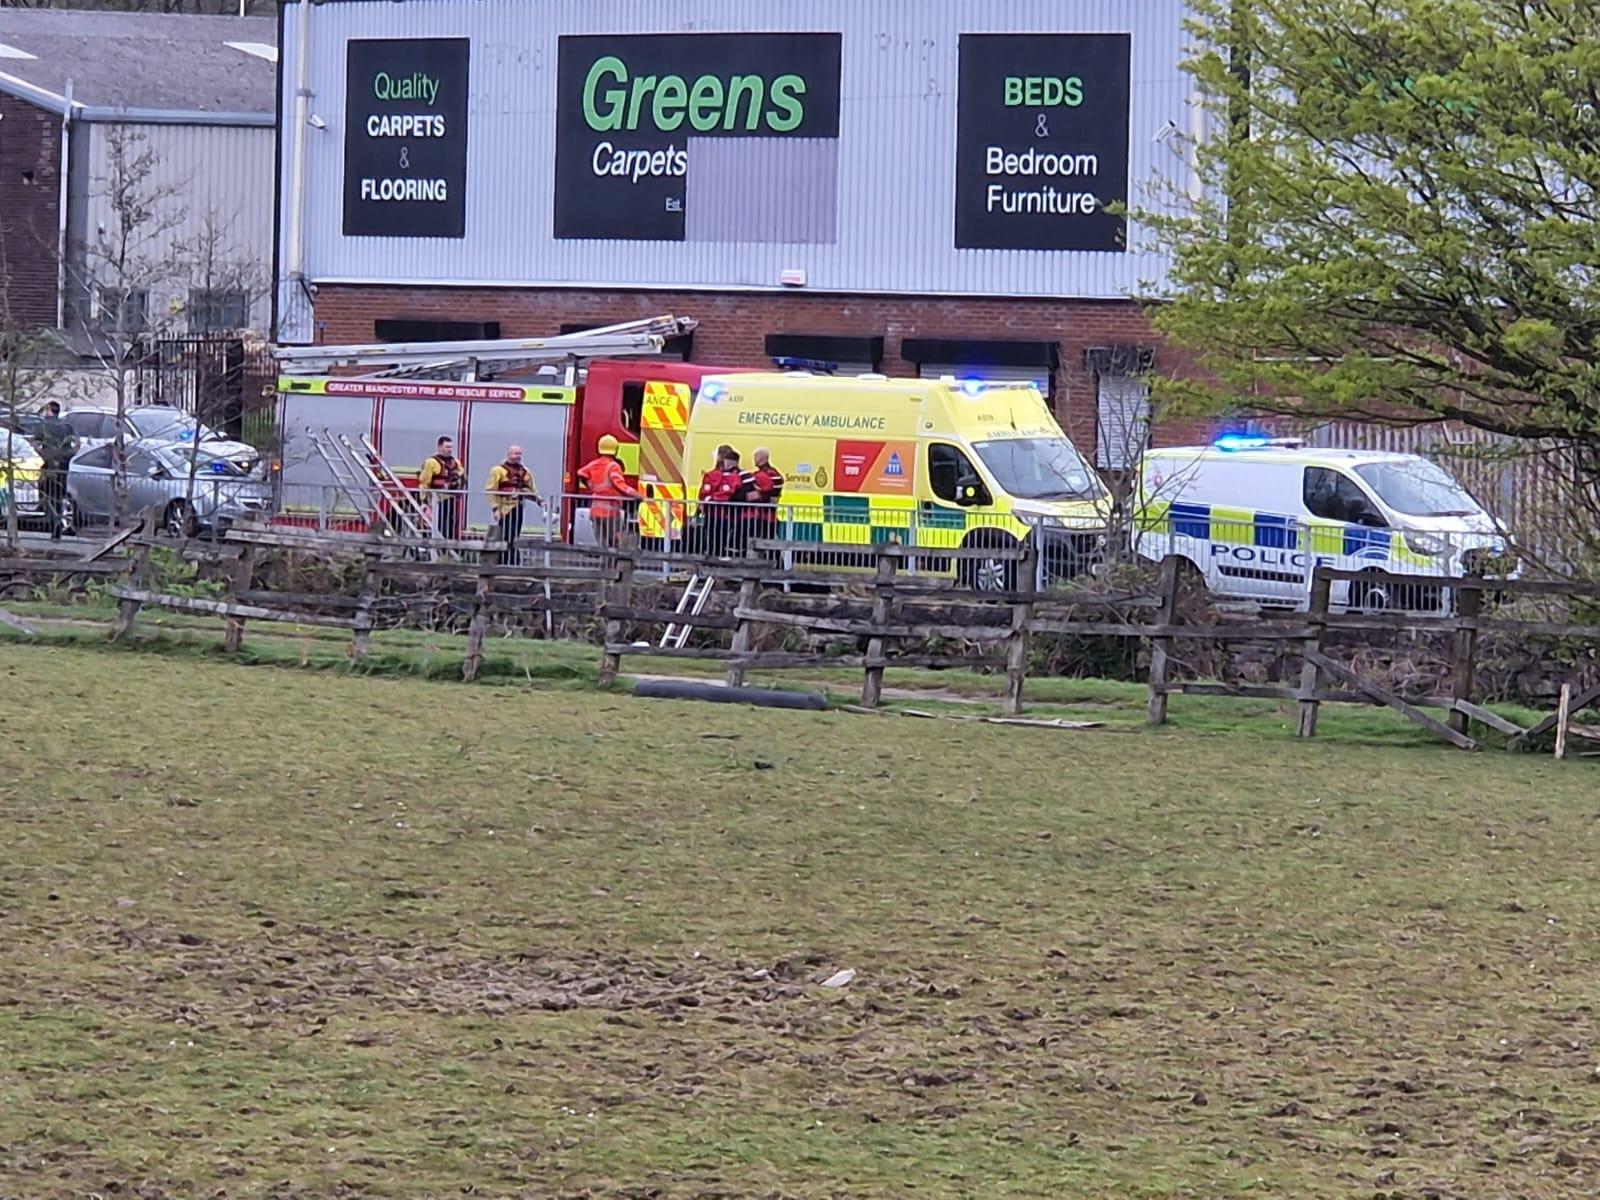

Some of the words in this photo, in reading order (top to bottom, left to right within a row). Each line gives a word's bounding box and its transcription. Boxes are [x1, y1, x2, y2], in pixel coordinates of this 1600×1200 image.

[374, 72, 440, 105] Quality
[582, 56, 806, 131] Greens
[1004, 77, 1083, 106] BEDS
[367, 115, 446, 137] CARPETS
[1035, 113, 1049, 137] &
[399, 147, 410, 169] &
[592, 142, 688, 183] Carpets
[986, 147, 1098, 176] Bedroom
[361, 179, 448, 201] FLOORING
[987, 185, 1096, 214] Furniture
[328, 383, 364, 392] GREATER
[738, 411, 811, 427] EMERGENCY
[812, 415, 886, 430] AMBULANCE
